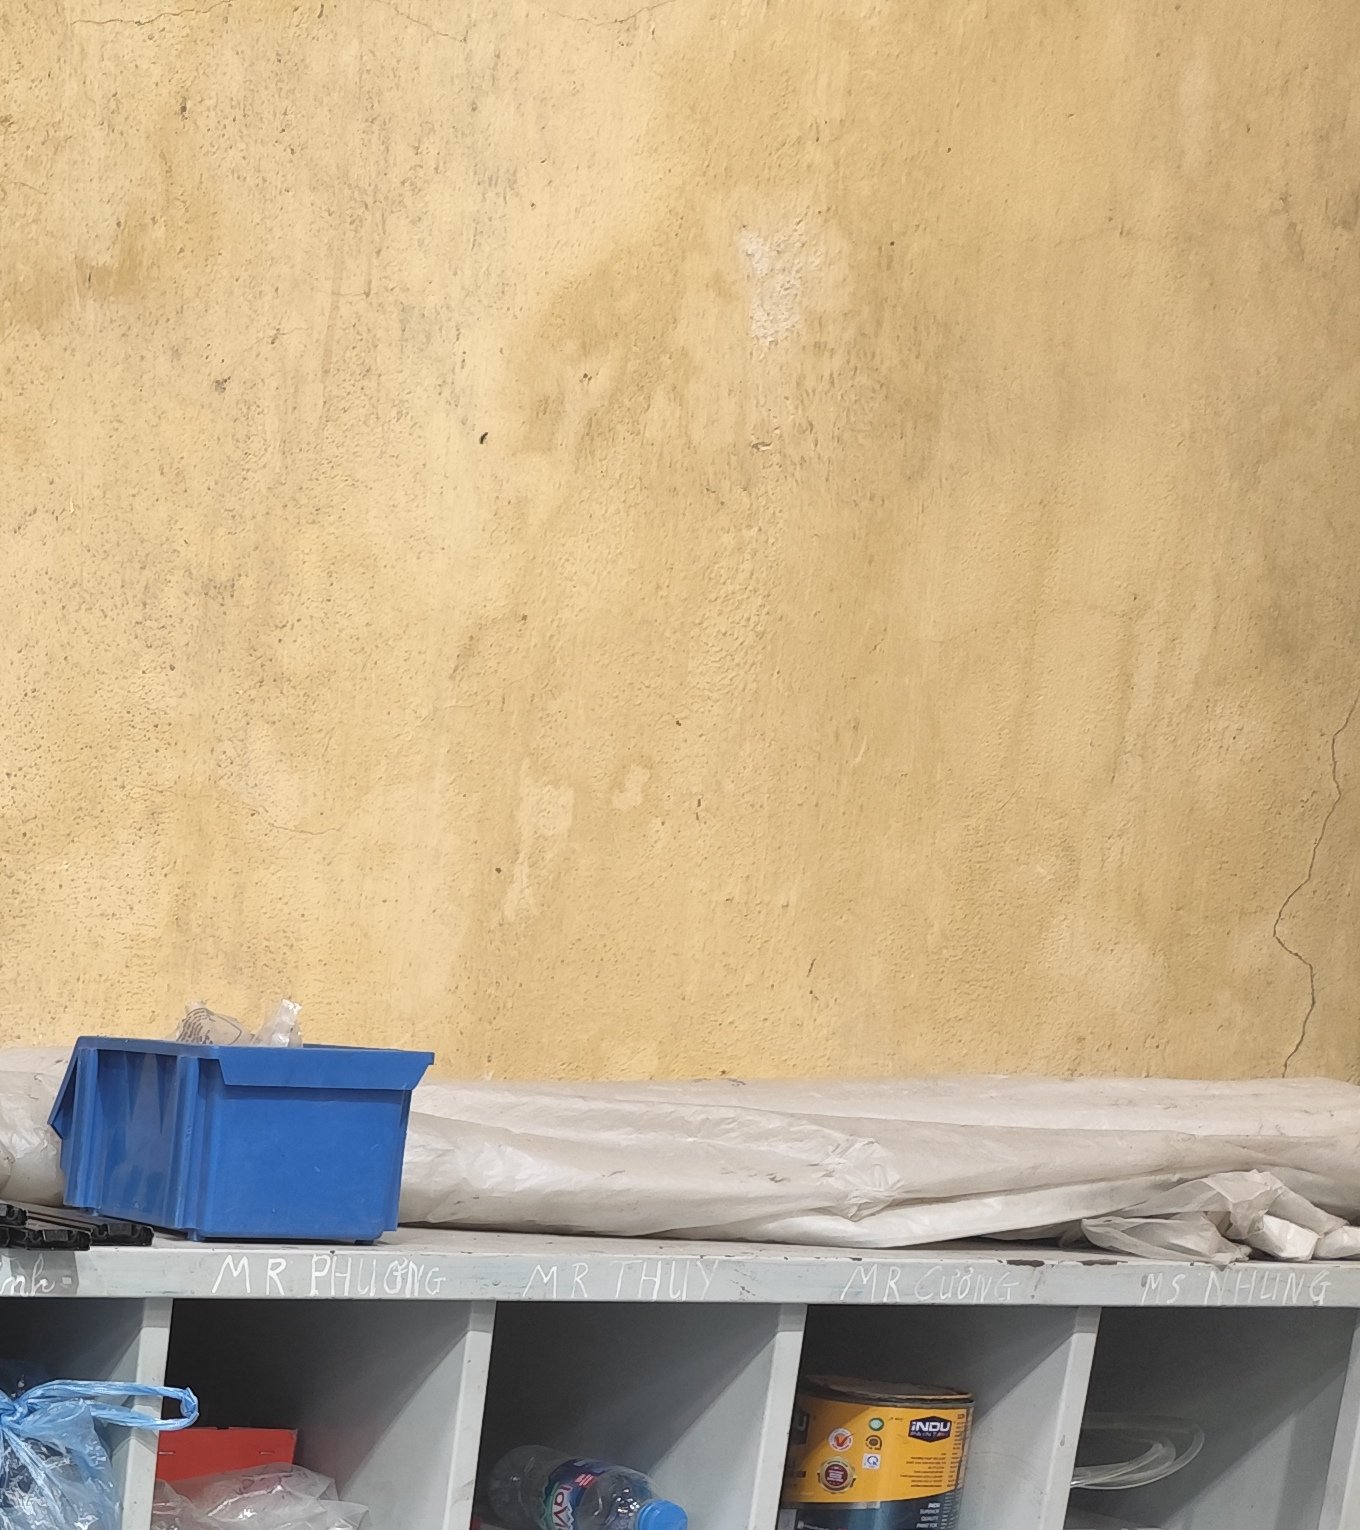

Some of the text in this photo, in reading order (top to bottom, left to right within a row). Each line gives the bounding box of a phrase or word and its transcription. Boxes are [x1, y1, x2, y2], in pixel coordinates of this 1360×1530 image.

[211, 1254, 287, 1296] MR
[522, 1262, 590, 1300] MR
[839, 1263, 902, 1303] MR
